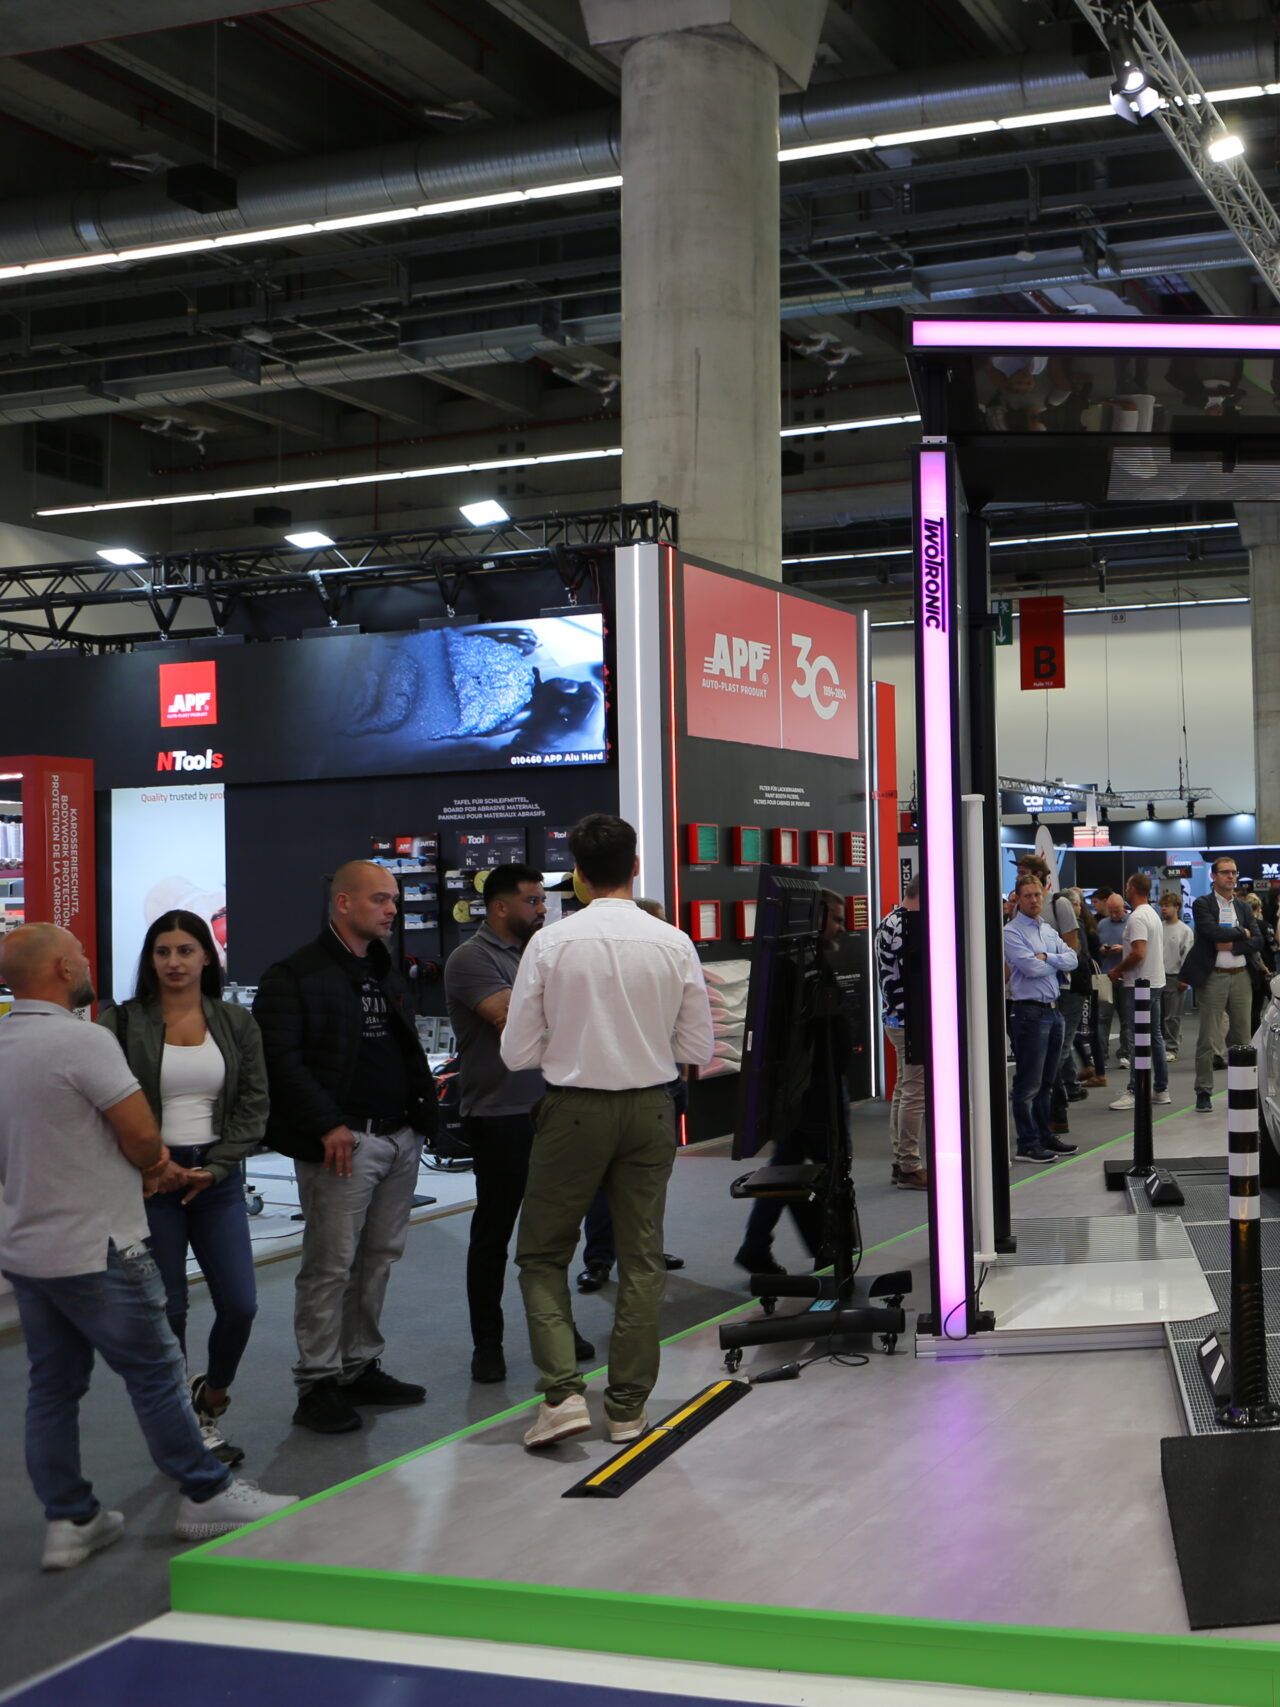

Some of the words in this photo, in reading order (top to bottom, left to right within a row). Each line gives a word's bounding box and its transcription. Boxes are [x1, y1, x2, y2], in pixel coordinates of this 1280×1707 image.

[924, 517, 946, 633] TWOTRONIC
[1033, 646, 1057, 679] B
[702, 678, 740, 693] AUTO-PLAST
[740, 687, 767, 699] PRODUKT
[157, 749, 224, 772] NTools
[543, 754, 562, 763] APP
[564, 752, 580, 762] Alu
[581, 752, 603, 761] Hard
[51, 775, 60, 841] PROTECTION
[141, 793, 168, 803] Quality
[169, 791, 197, 801] trusted
[199, 791, 208, 801] by
[61, 795, 69, 857] BODYWORK
[52, 843, 60, 859] DE
[70, 808, 79, 916] KAROSSERIESCHUTZ,
[53, 861, 61, 875] LA
[53, 877, 62, 927] CARROSS
